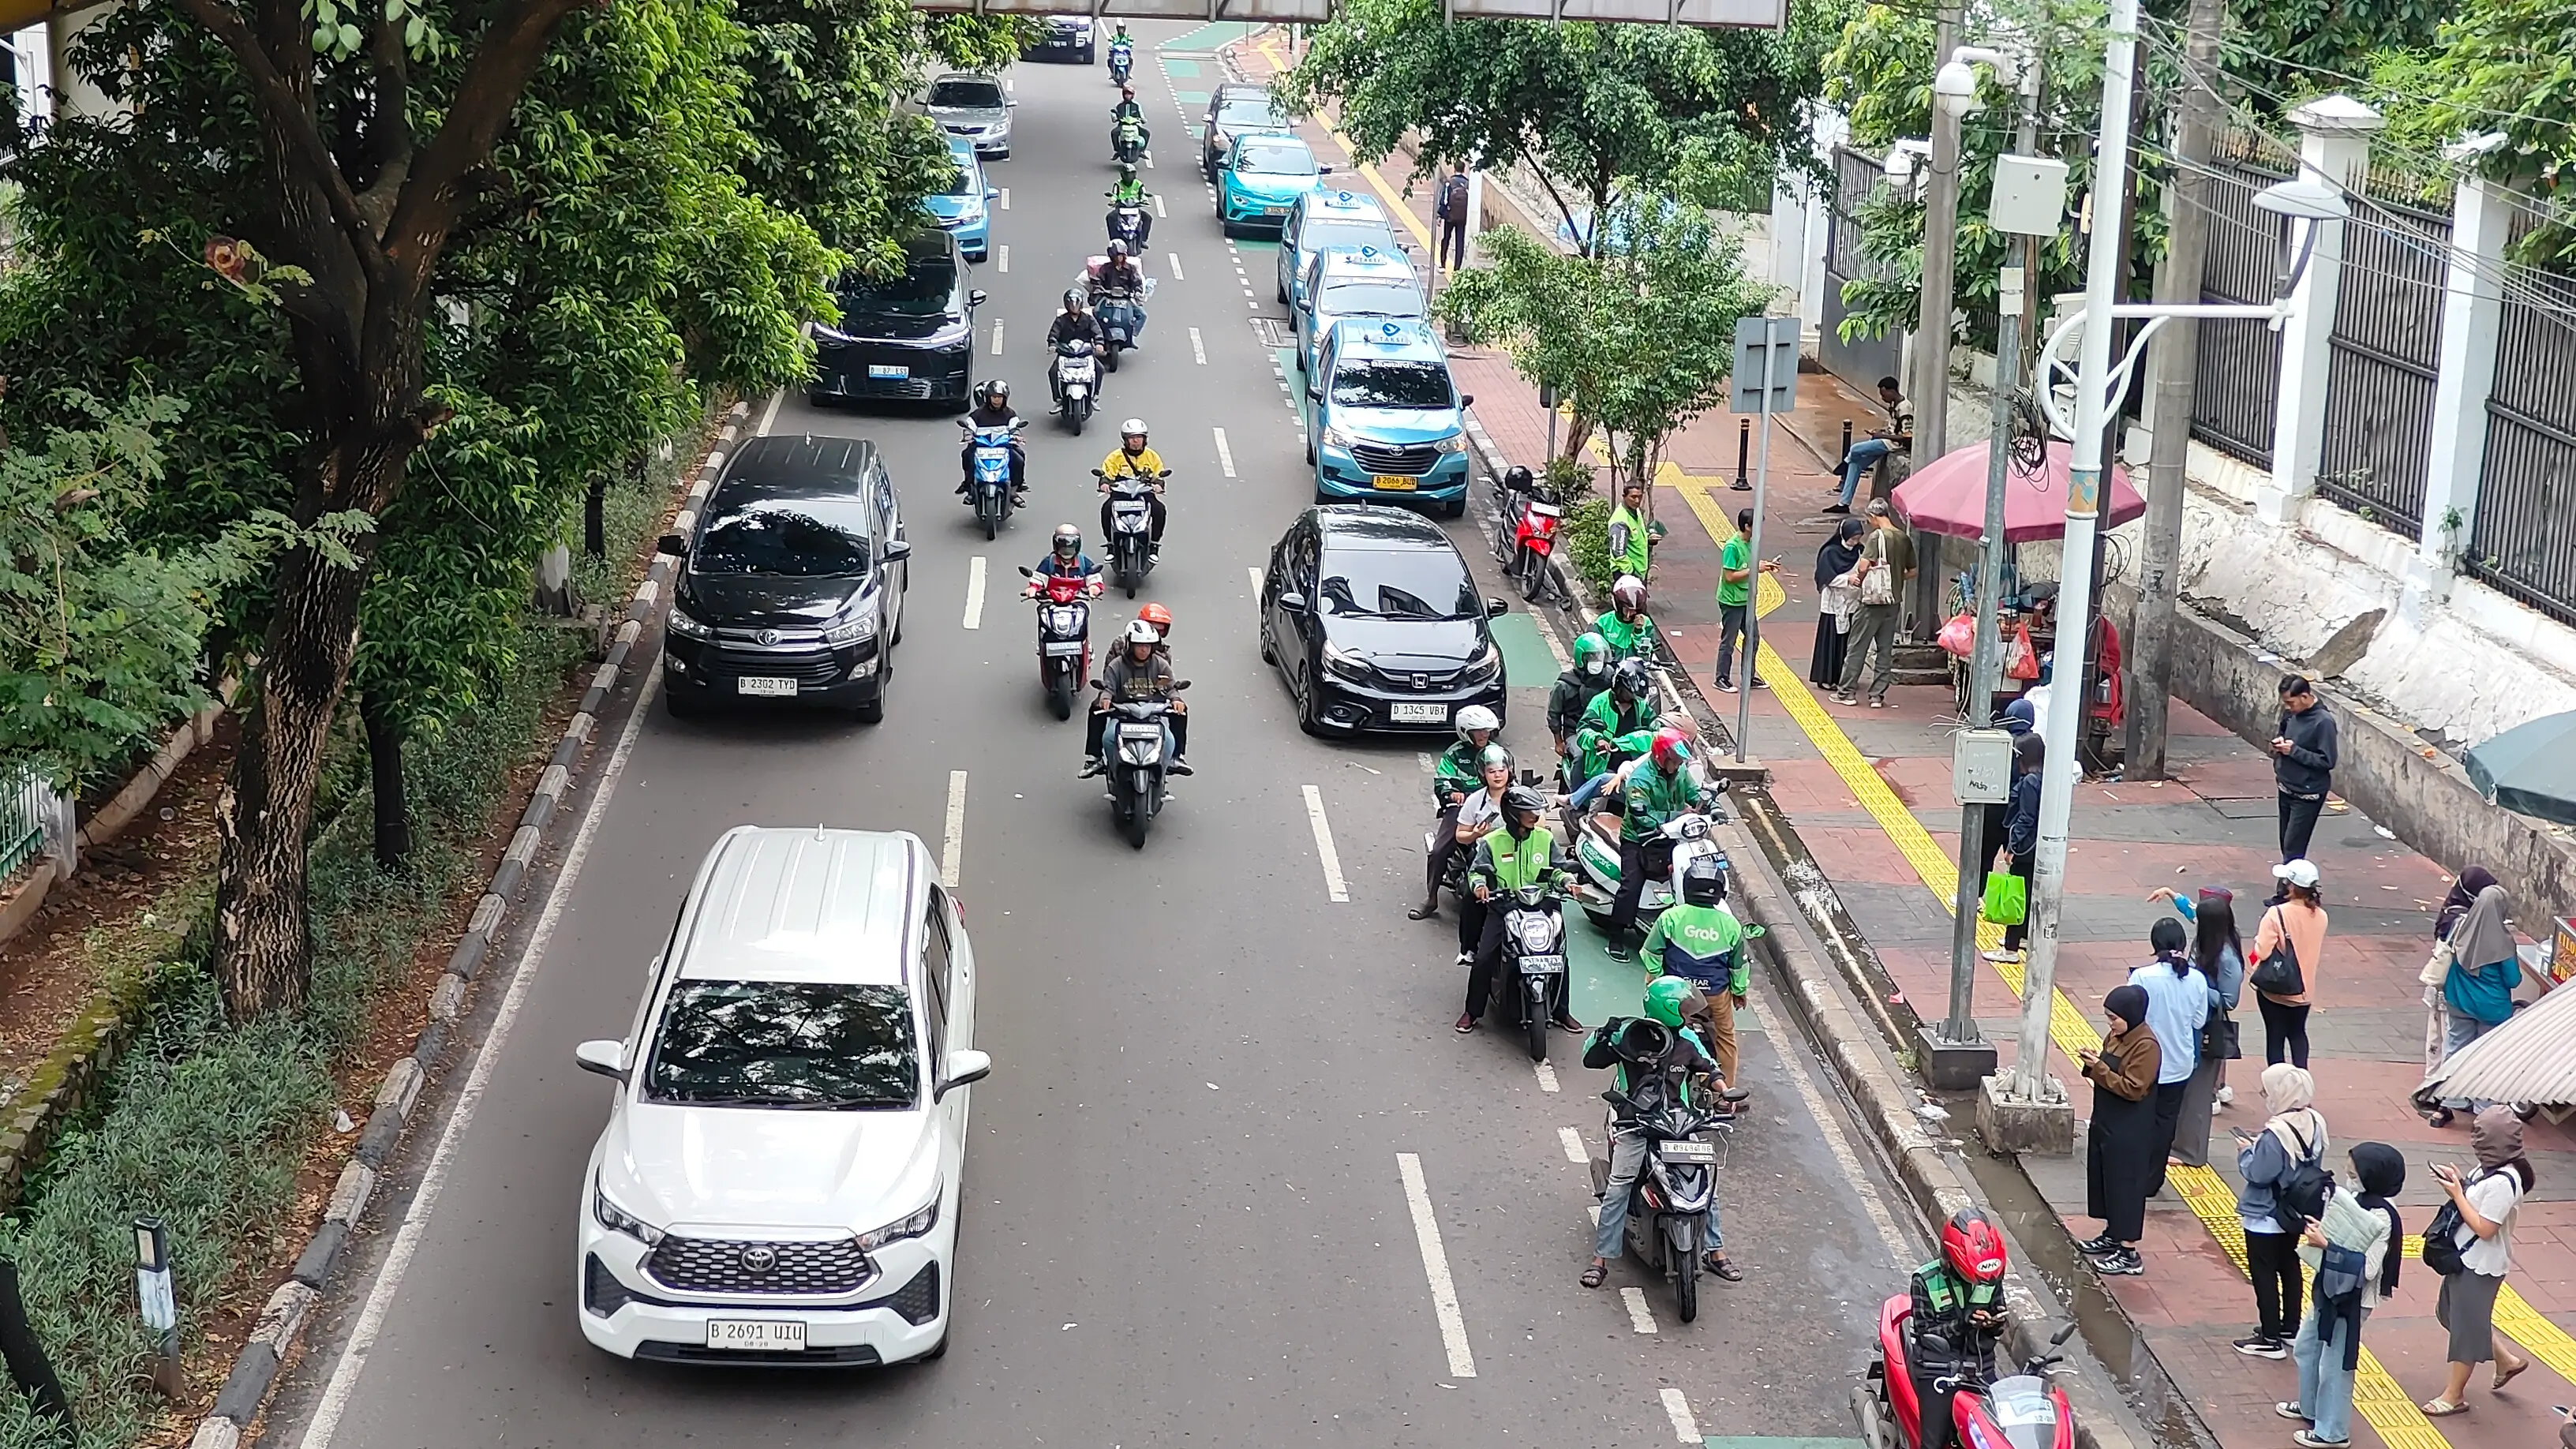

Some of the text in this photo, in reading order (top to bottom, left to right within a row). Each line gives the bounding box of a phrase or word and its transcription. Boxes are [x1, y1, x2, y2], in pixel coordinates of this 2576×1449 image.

[740, 679, 795, 690] B 2302 TYD
[1394, 705, 1445, 716] D 1345 VBX
[1684, 924, 1720, 942] Grab
[1669, 1064, 1687, 1073] Grab
[711, 1324, 803, 1340] B 2691 UIU
